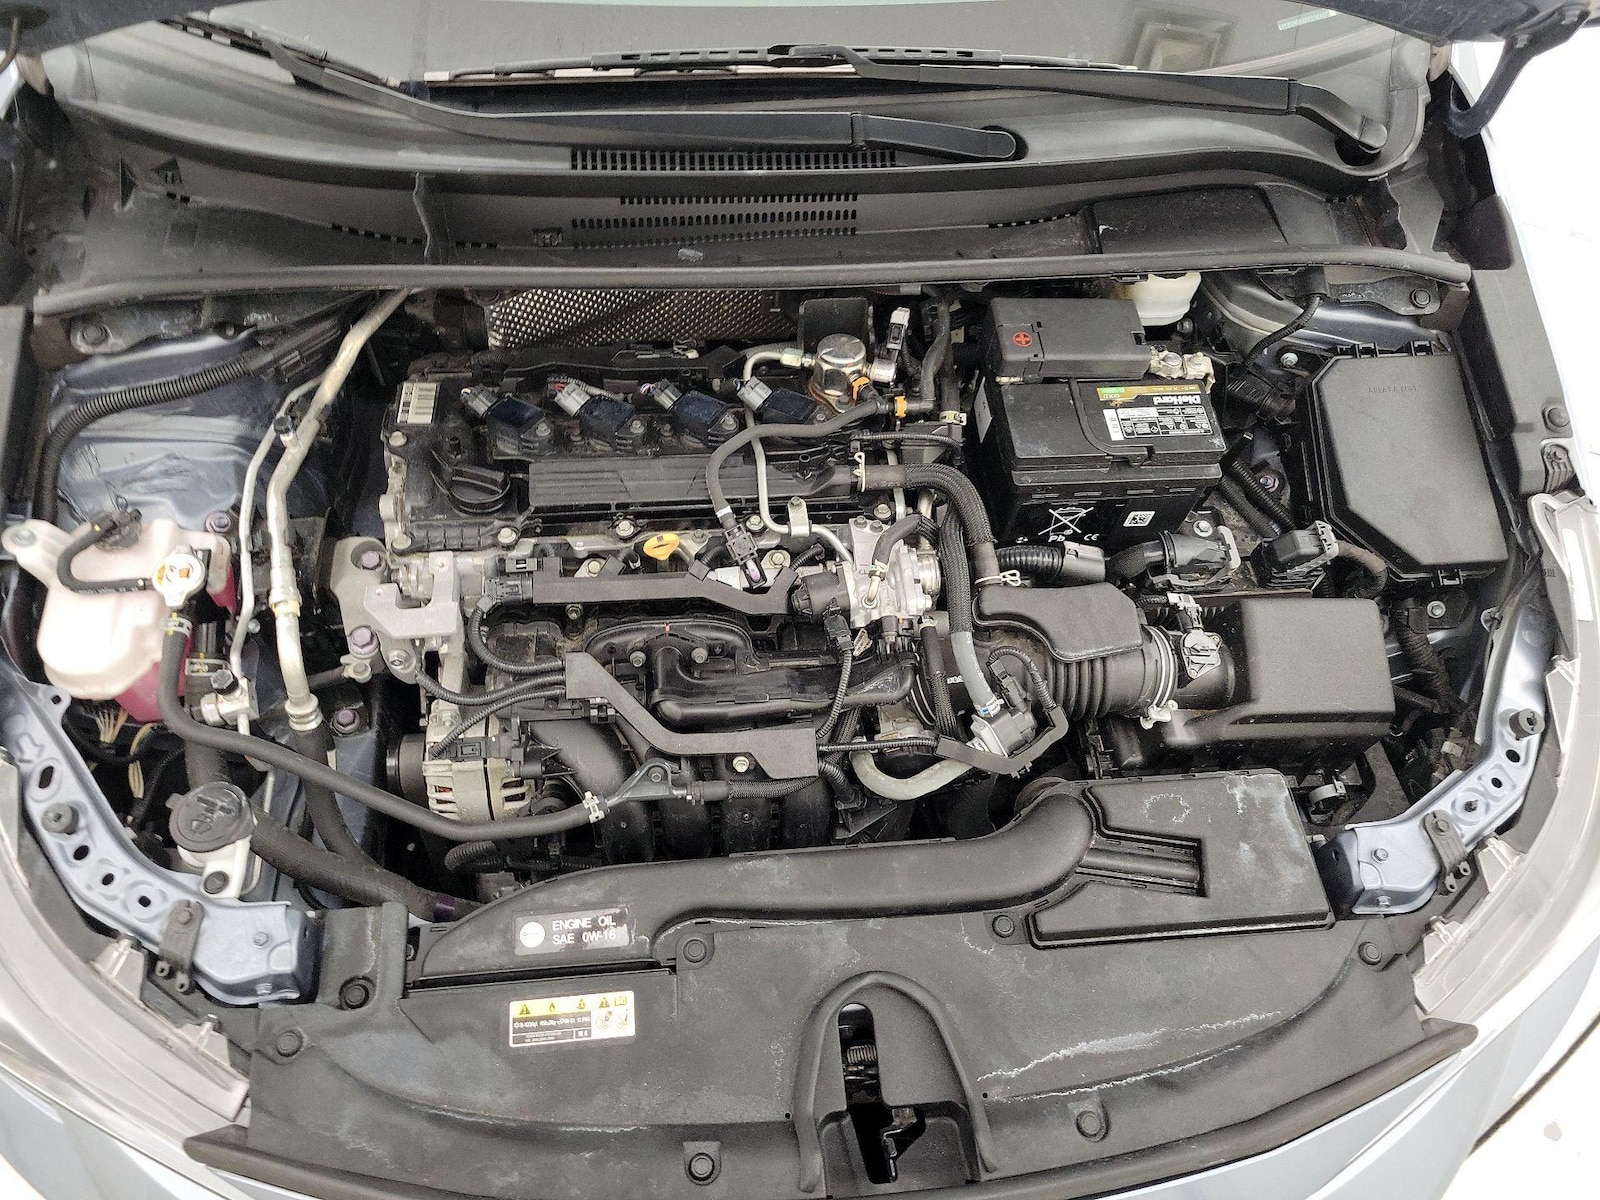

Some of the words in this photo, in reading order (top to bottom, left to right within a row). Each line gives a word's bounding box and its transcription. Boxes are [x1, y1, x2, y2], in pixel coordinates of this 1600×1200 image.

[1152, 394, 1201, 405] DieHard
[1047, 534, 1066, 543] Pb
[1083, 533, 1100, 541] CE
[552, 917, 592, 931] ENGINE
[598, 915, 616, 927] OIL
[552, 933, 575, 945] SAE
[582, 929, 617, 942] 0W-16
